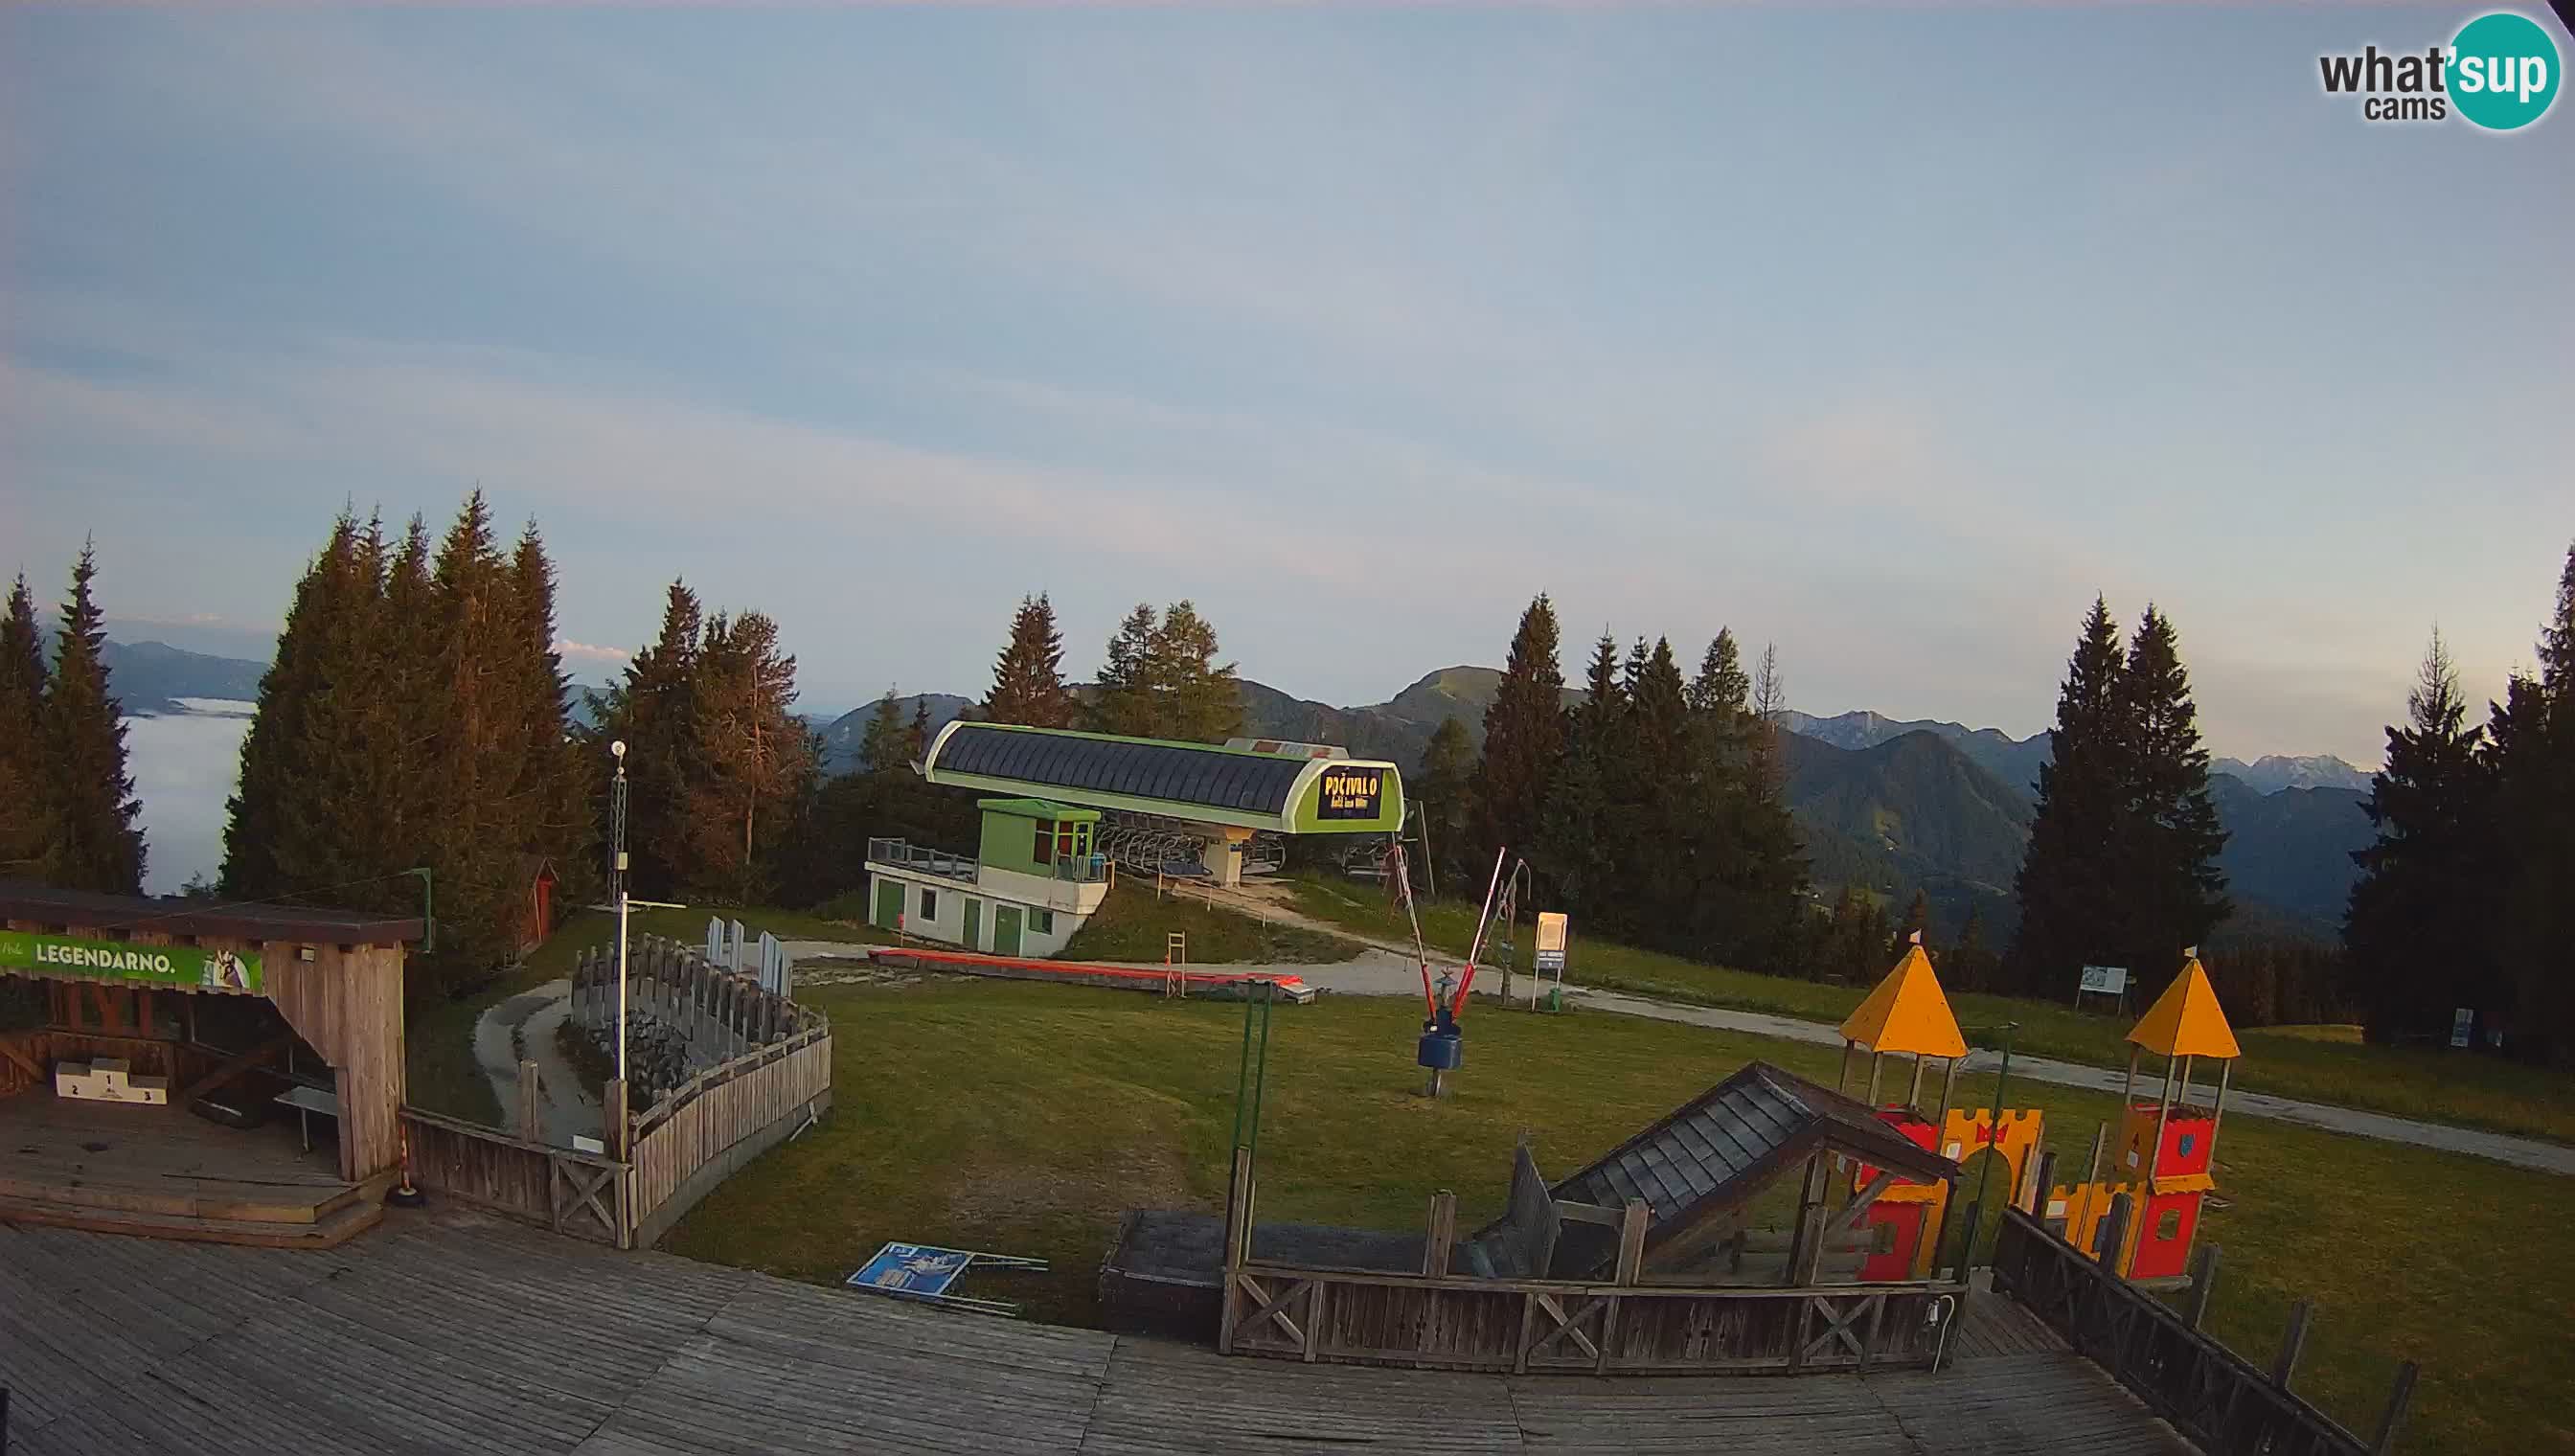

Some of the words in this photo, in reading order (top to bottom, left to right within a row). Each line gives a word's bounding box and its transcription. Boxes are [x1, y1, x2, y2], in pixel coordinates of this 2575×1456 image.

[36, 944, 175, 973] LEGENDARNO.
[105, 1074, 112, 1085] 1
[72, 1085, 79, 1095] 2
[145, 1091, 151, 1102] 3
